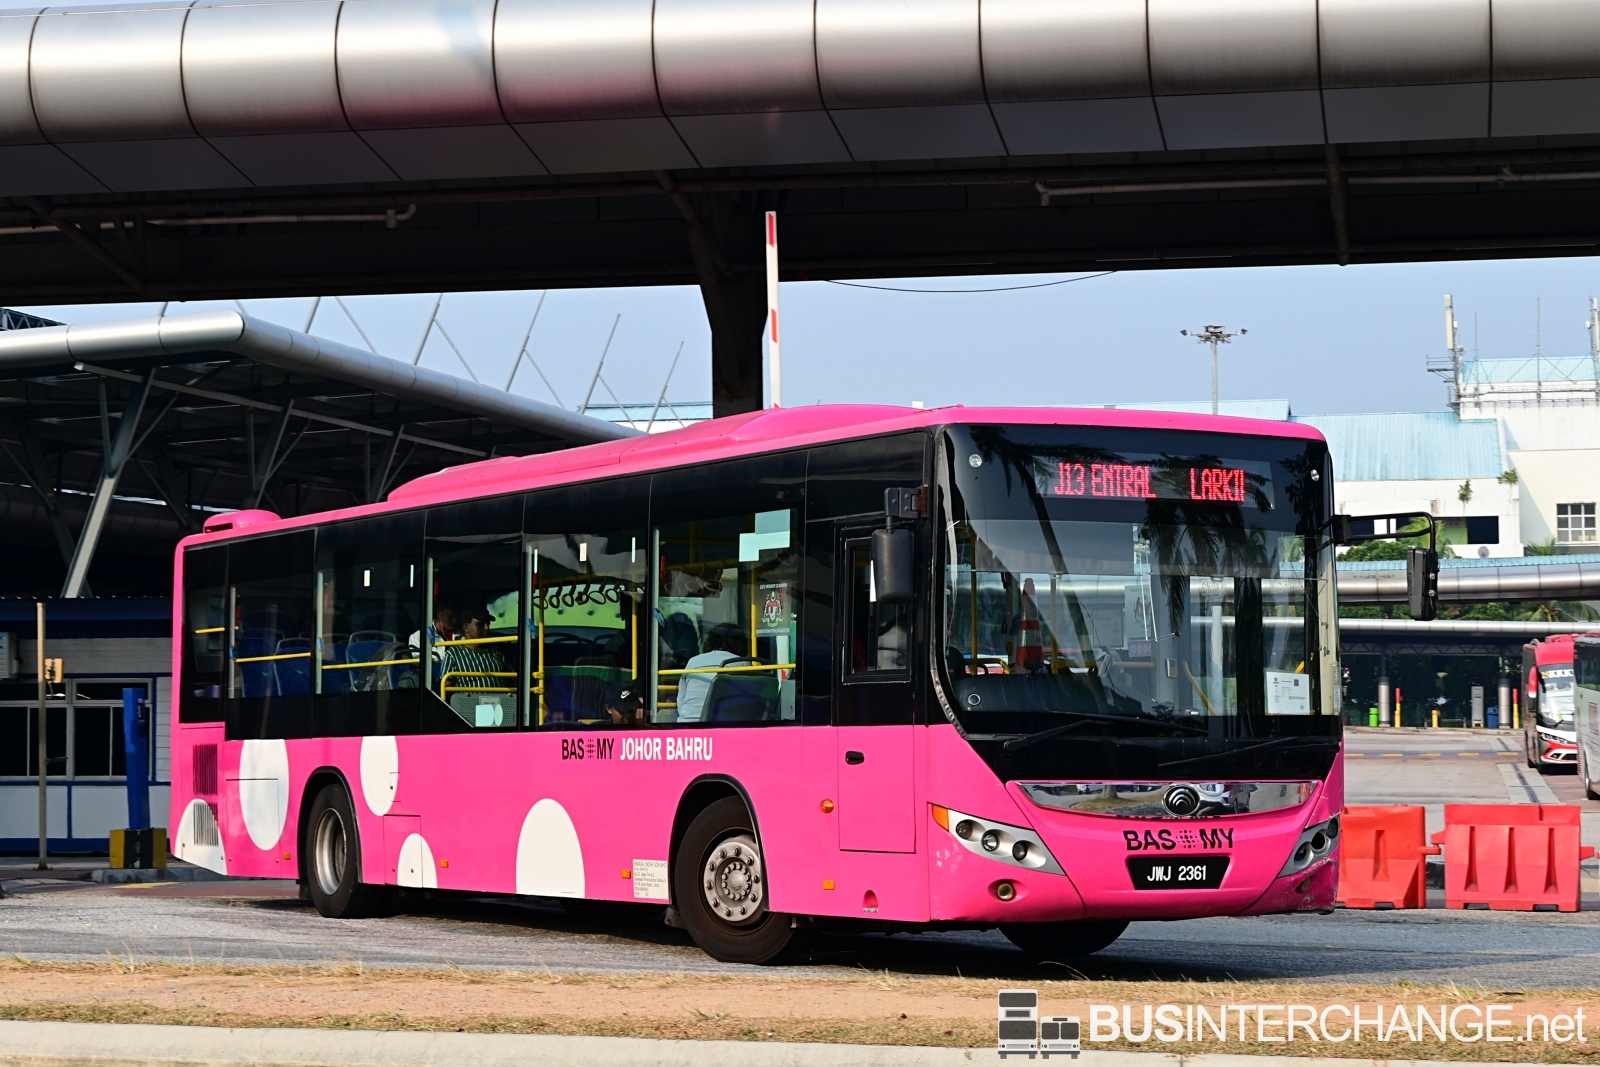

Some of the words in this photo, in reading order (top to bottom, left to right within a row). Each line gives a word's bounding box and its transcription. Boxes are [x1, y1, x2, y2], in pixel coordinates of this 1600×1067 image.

[1054, 462, 1086, 495] J13
[1091, 464, 1157, 498] ENTRAL
[561, 738, 585, 760] BAS
[596, 738, 615, 760] MY
[620, 737, 662, 761] JOHOR
[666, 736, 713, 761] BAHRU
[1123, 829, 1177, 851] BAS
[1199, 827, 1235, 850] MY
[1146, 865, 1172, 882] JWJ
[1178, 865, 1207, 881] 2361
